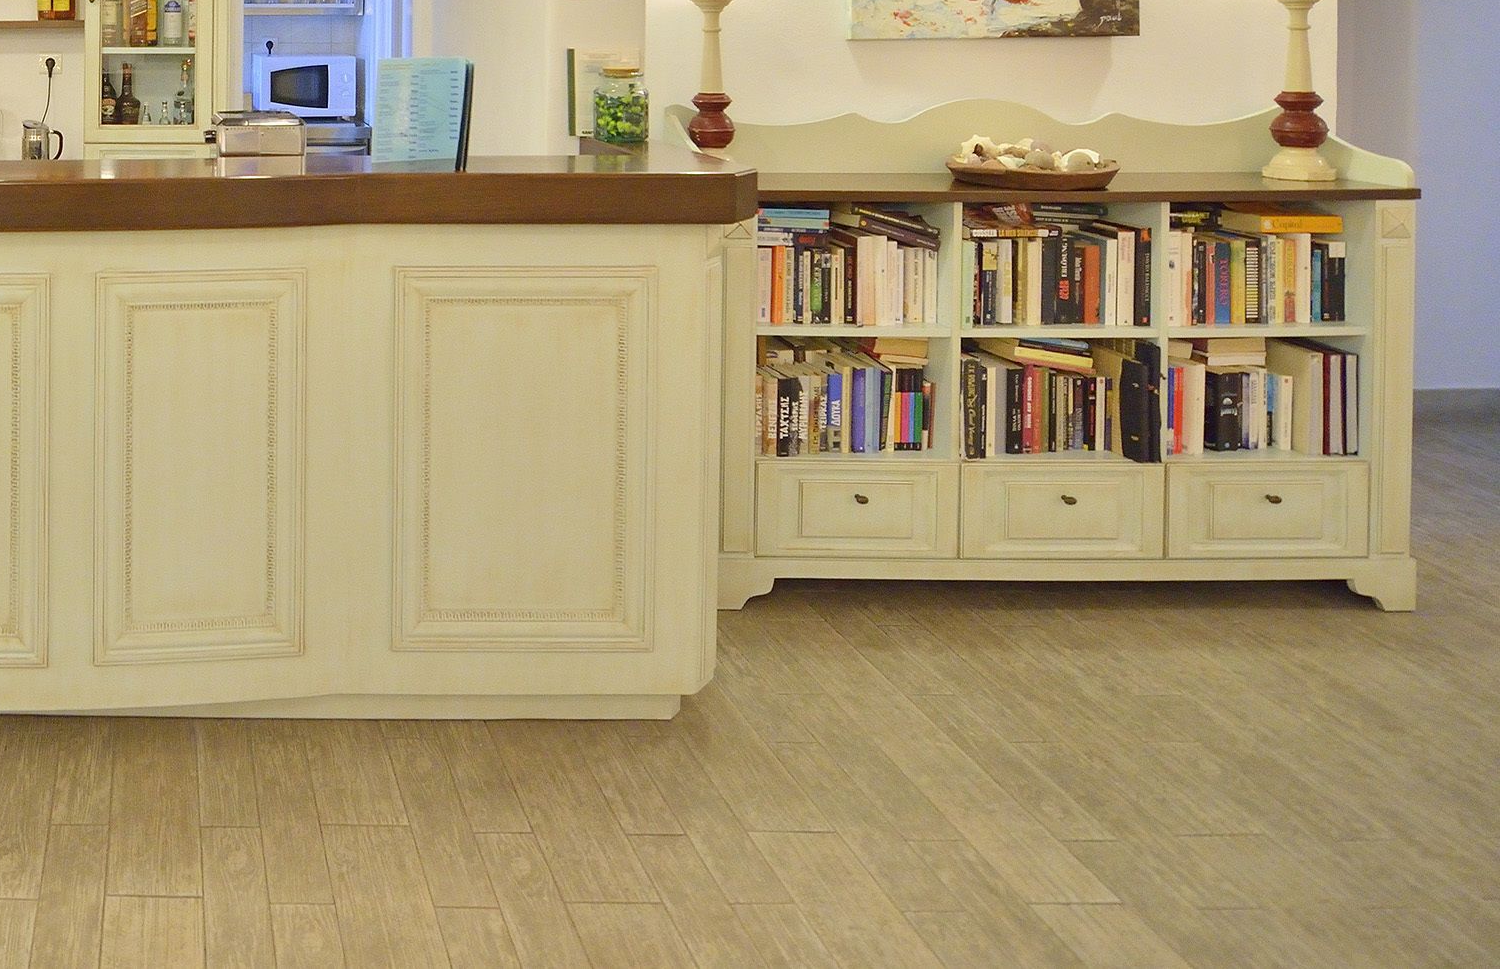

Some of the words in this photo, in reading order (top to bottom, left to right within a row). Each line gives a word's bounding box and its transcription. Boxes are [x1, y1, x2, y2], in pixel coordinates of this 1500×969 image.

[780, 396, 789, 439] ΤΑΧΤΣΗΣ
[819, 394, 827, 429] ΤΣΙΡΚΑΣ
[831, 400, 841, 426] ΔΟΥΚΑ
